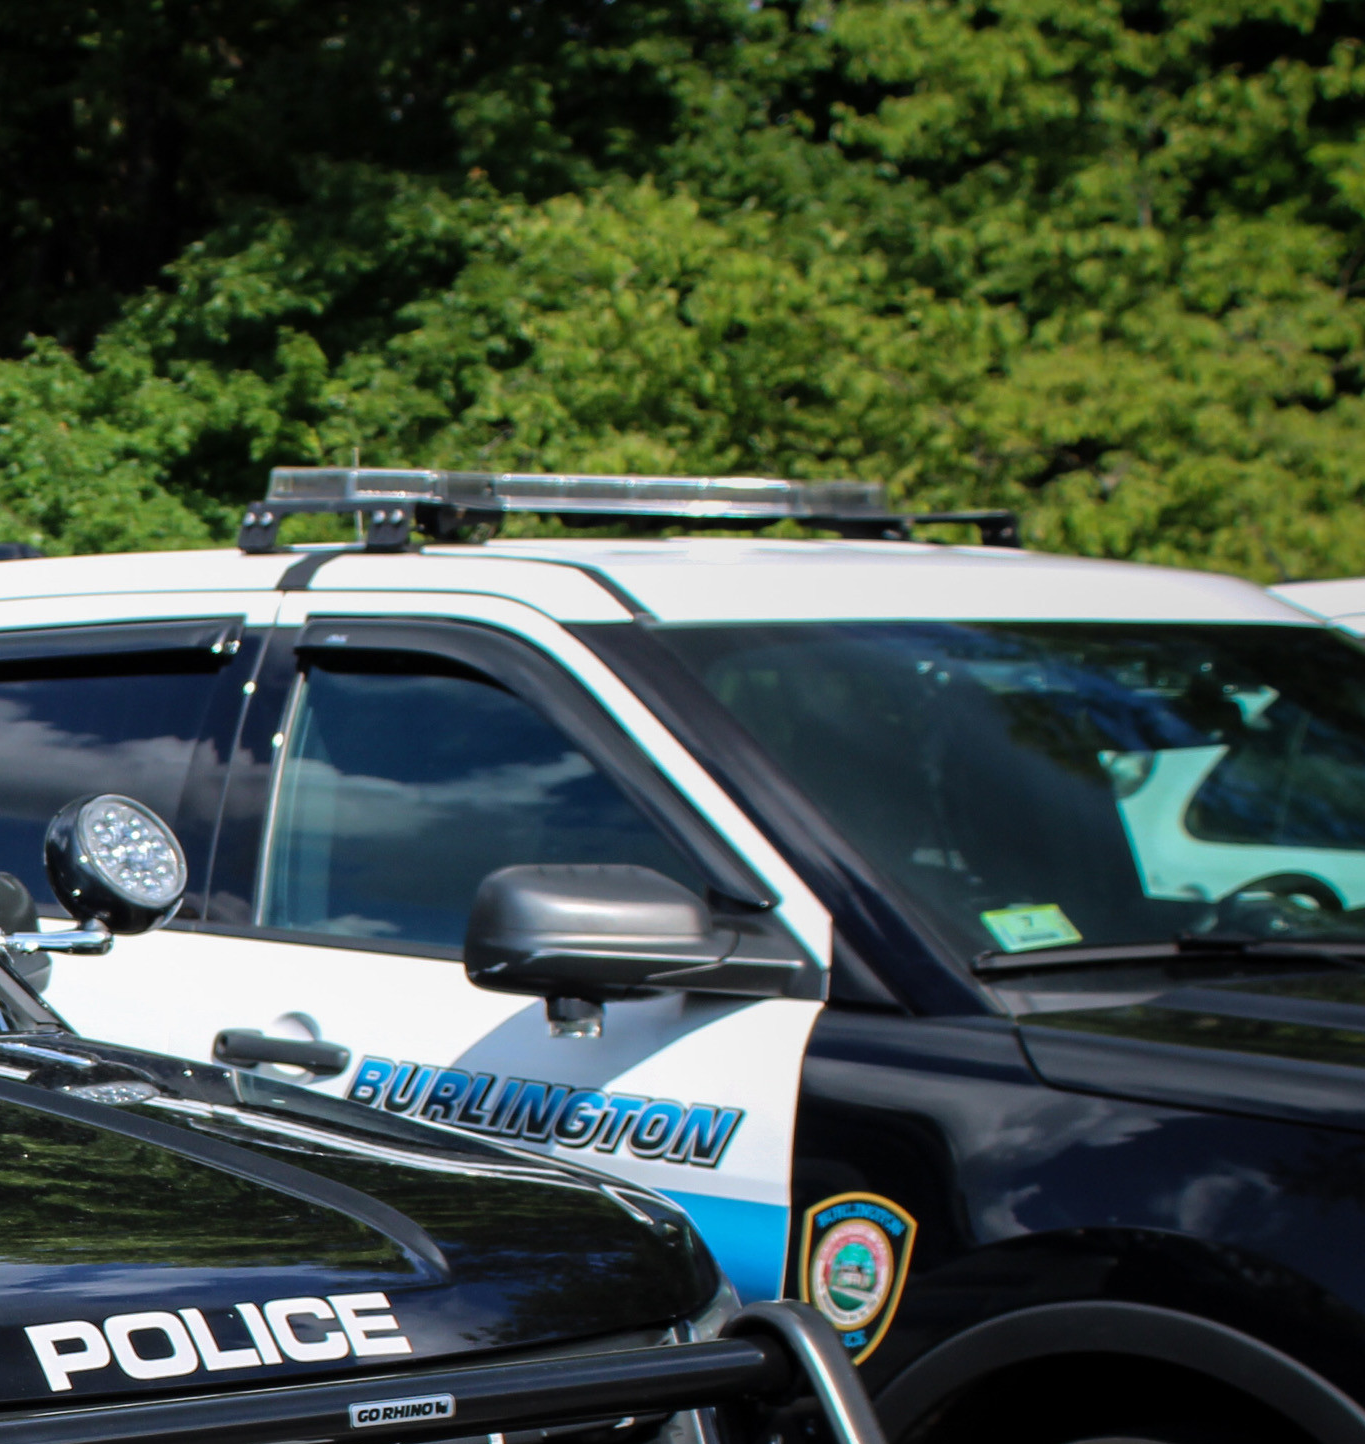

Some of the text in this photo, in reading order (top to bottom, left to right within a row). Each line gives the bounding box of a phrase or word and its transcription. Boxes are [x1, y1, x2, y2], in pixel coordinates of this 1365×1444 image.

[346, 1055, 746, 1169] BURLINGTON
[24, 1292, 413, 1392] POLICE
[357, 1402, 433, 1423] GO RHINO
